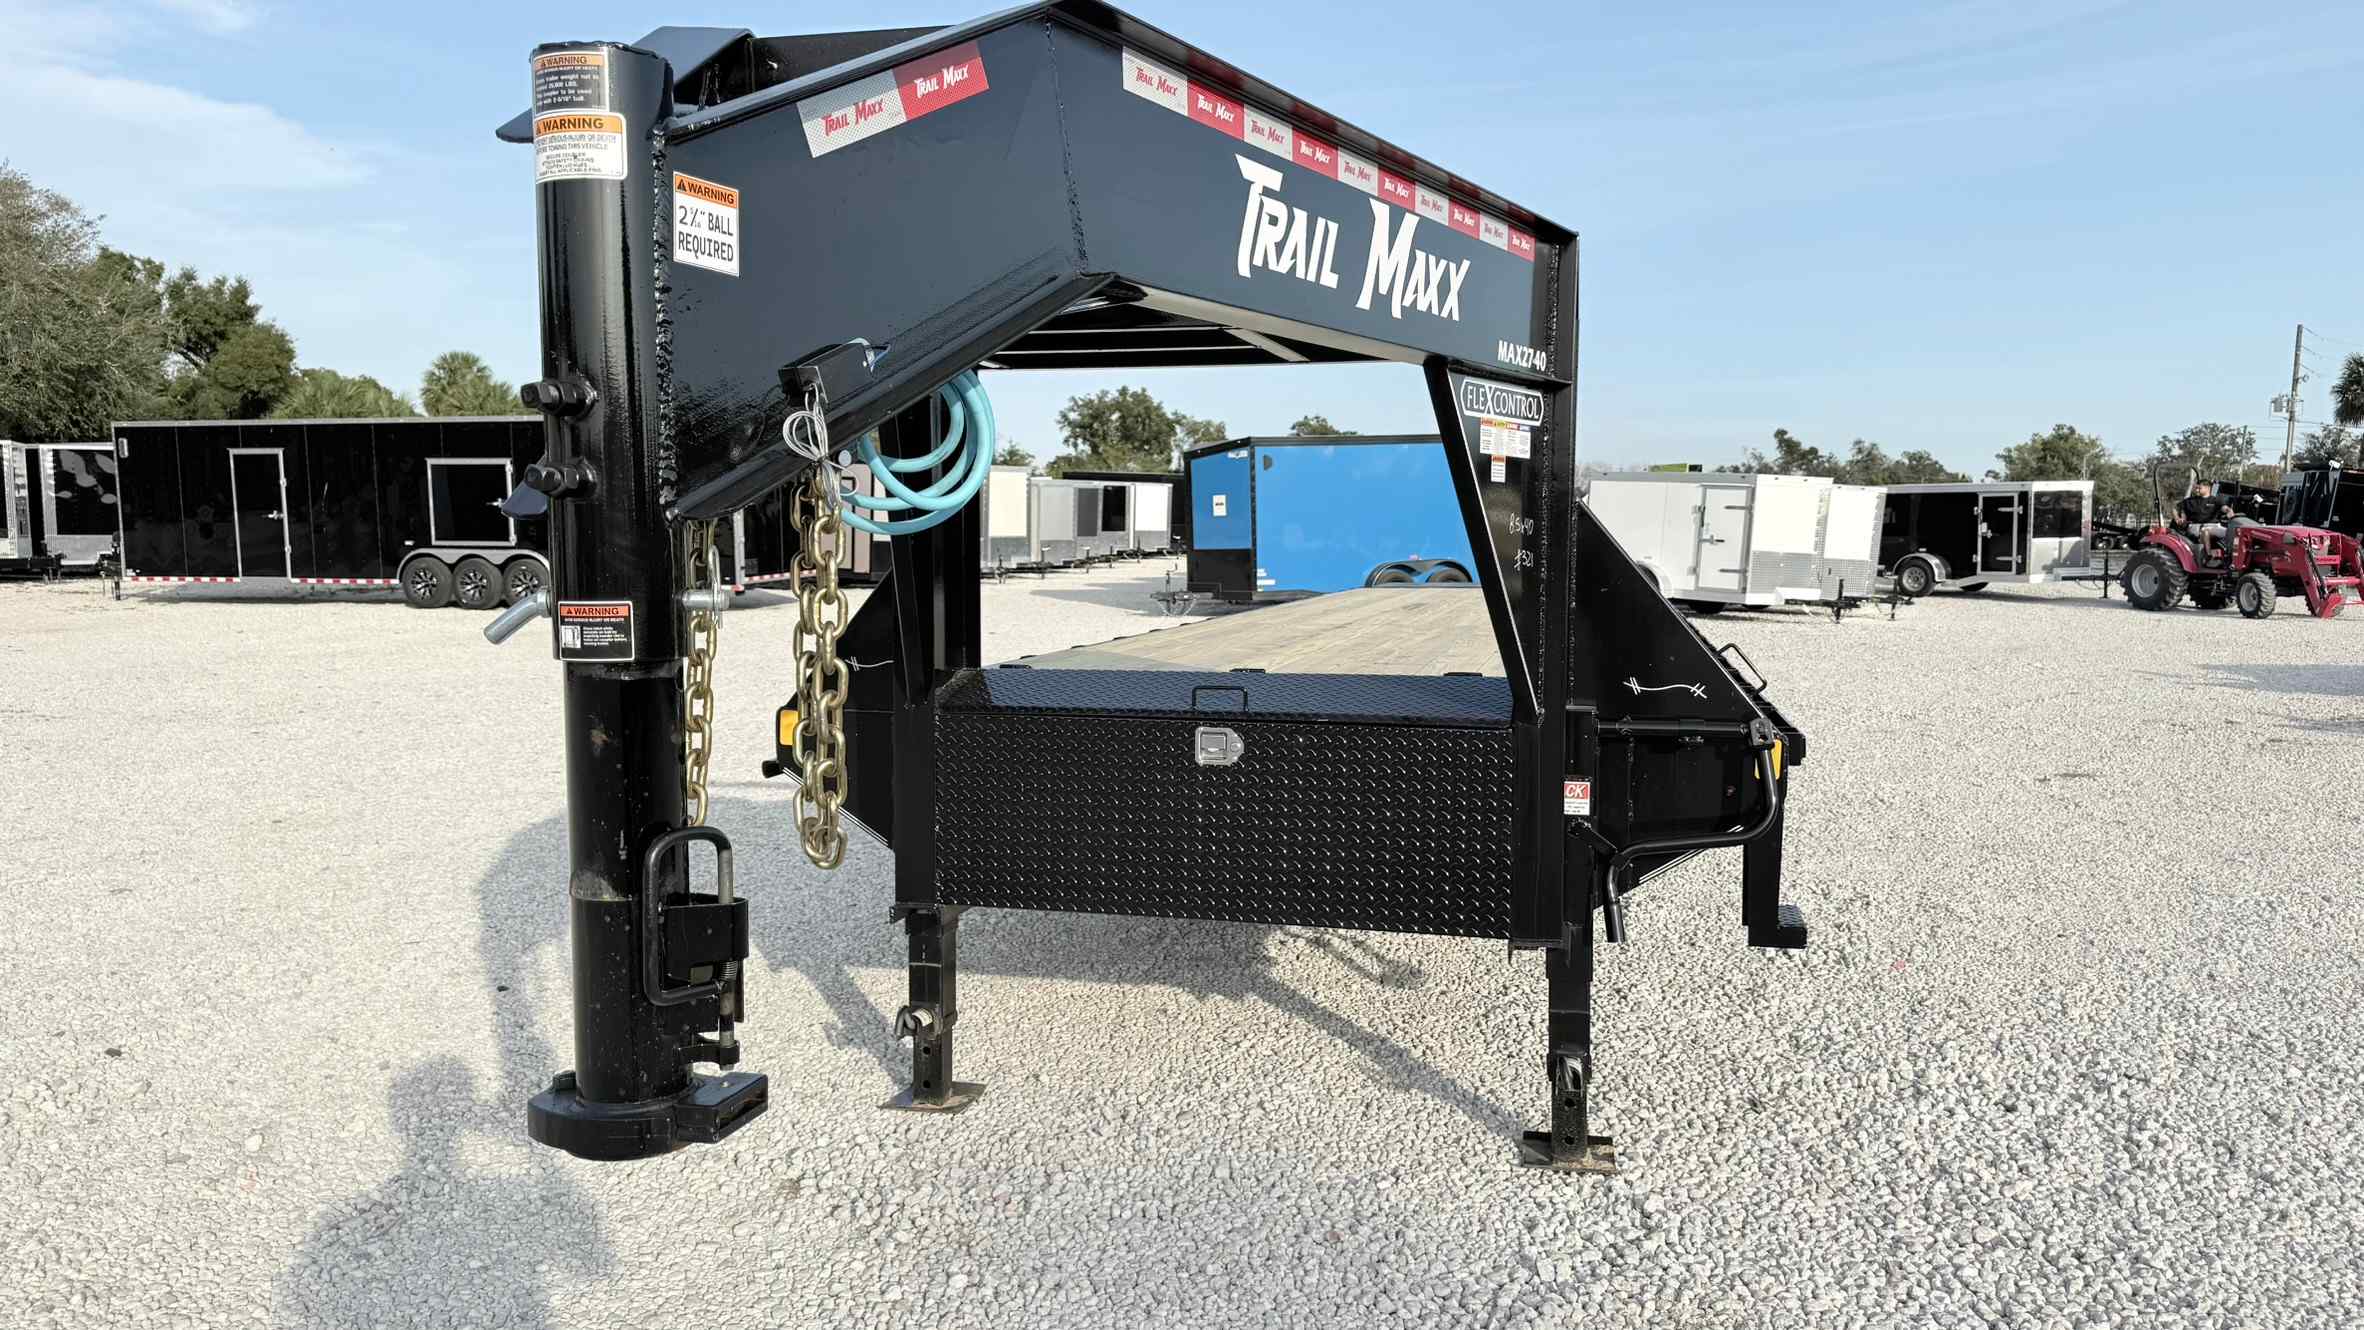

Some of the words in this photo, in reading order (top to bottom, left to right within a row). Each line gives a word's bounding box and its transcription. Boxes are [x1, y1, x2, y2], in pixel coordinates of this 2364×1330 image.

[546, 56, 587, 66] WARNING
[914, 77, 940, 98] TRAIL
[941, 64, 969, 89] MAXX
[1136, 67, 1154, 87] TRAIL
[1156, 76, 1178, 96] MAXX
[821, 114, 850, 137] TRAIL
[854, 98, 884, 125] MAXX
[1197, 95, 1213, 113] TRAIL
[1215, 104, 1235, 122] MAXX
[543, 118, 604, 131] WARNING
[1250, 120, 1265, 137] TRAIL
[1267, 127, 1284, 144] MAXX
[688, 182, 734, 204] WARNING
[708, 213, 734, 236] BALL
[1235, 154, 1339, 289] TRAIL
[1356, 198, 1471, 322] MAXX
[678, 230, 734, 262] REQUIRED
[1498, 340, 1547, 372] MAX2740
[1467, 384, 1539, 420] FLEXCONTROL
[574, 607, 619, 615] WARNING
[1566, 784, 1586, 798] CK
